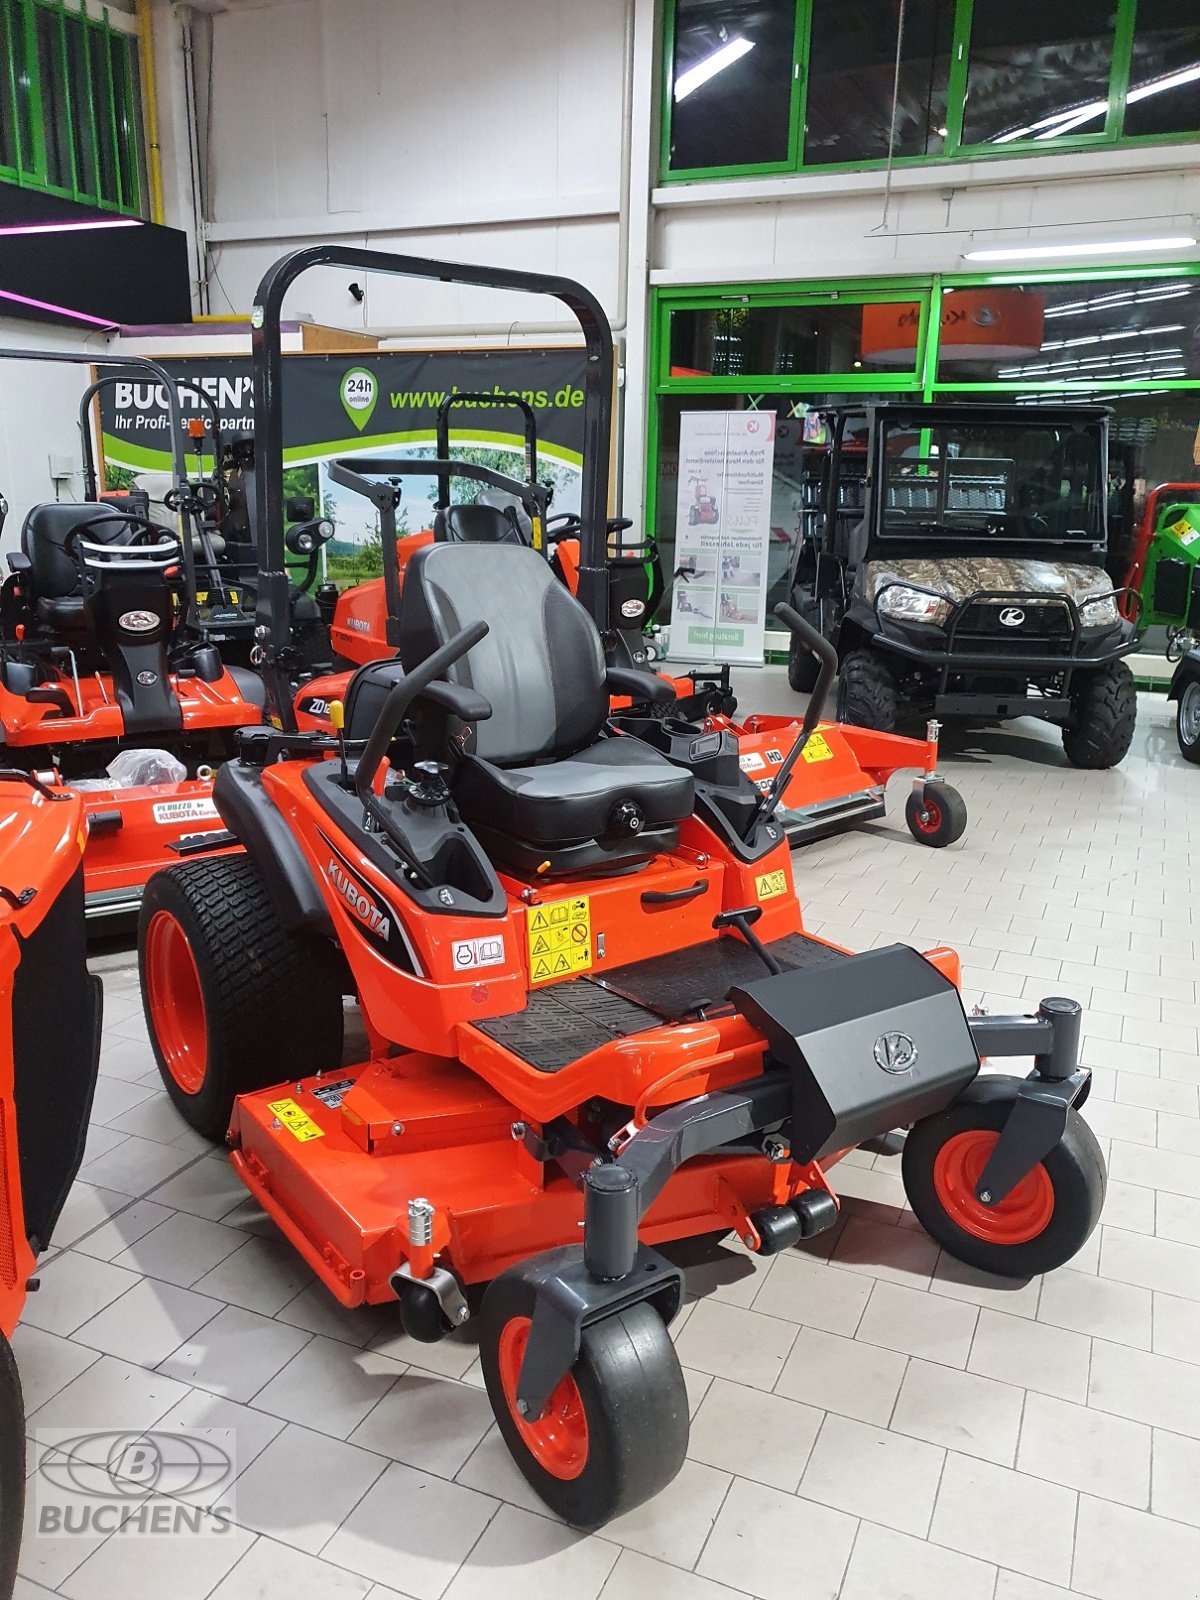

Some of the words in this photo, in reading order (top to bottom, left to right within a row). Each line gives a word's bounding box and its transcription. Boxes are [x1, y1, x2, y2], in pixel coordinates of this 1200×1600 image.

[115, 376, 254, 409] BUCHEN'
[348, 379, 371, 392] 24h
[115, 414, 133, 429] Ihr
[346, 616, 371, 633] KUBOTA
[766, 751, 782, 762] HD
[157, 802, 192, 812] PERUZZO
[158, 809, 199, 820] KUBOTA
[327, 858, 391, 942] KUBOTA
